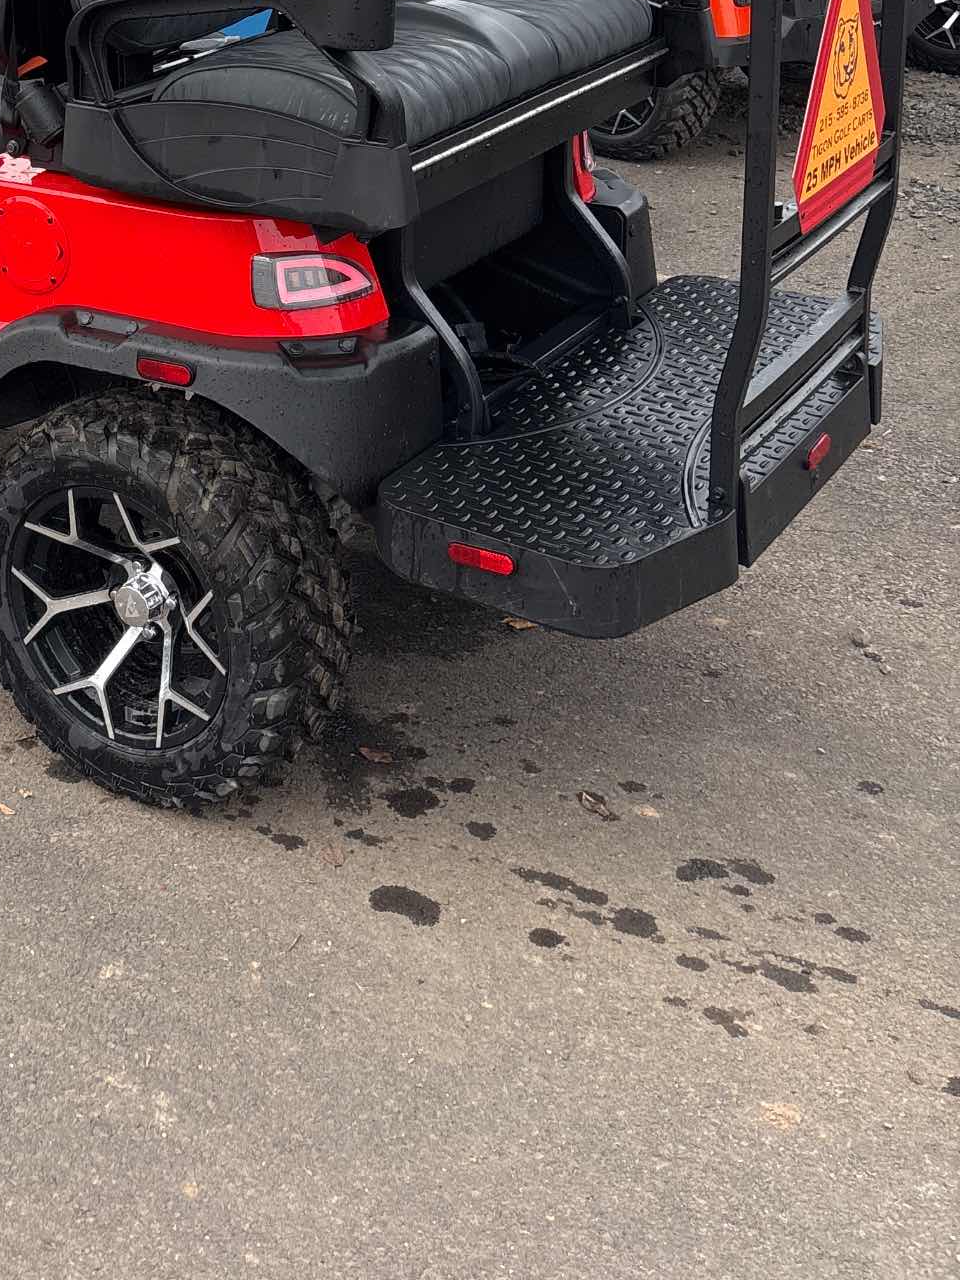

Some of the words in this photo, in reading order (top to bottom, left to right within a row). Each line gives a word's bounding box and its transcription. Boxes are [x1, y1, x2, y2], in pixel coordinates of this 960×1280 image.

[833, 122, 851, 144] GOLF
[852, 108, 873, 131] CARTS
[805, 168, 819, 193] 25
[820, 150, 841, 183] MPH
[843, 129, 875, 164] Vehicle
